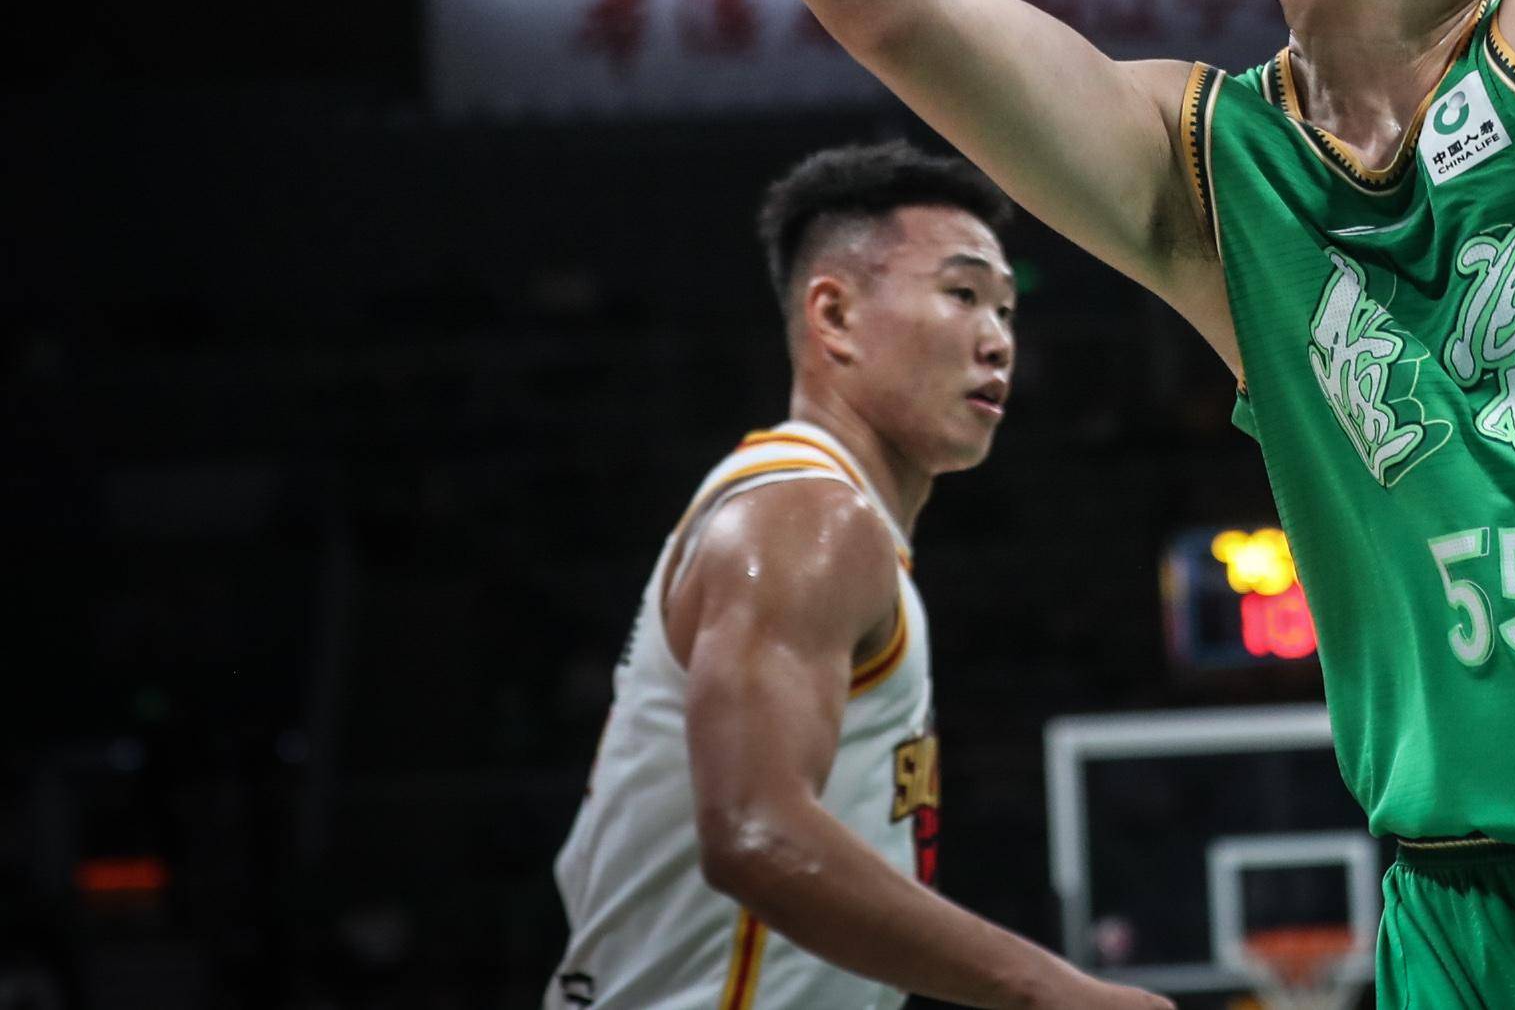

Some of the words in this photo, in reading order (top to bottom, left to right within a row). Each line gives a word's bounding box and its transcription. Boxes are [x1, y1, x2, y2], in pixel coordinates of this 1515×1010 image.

[1432, 119, 1494, 165] 中国人寿
[1437, 150, 1475, 175] CHINA
[1474, 132, 1501, 152] LIFE
